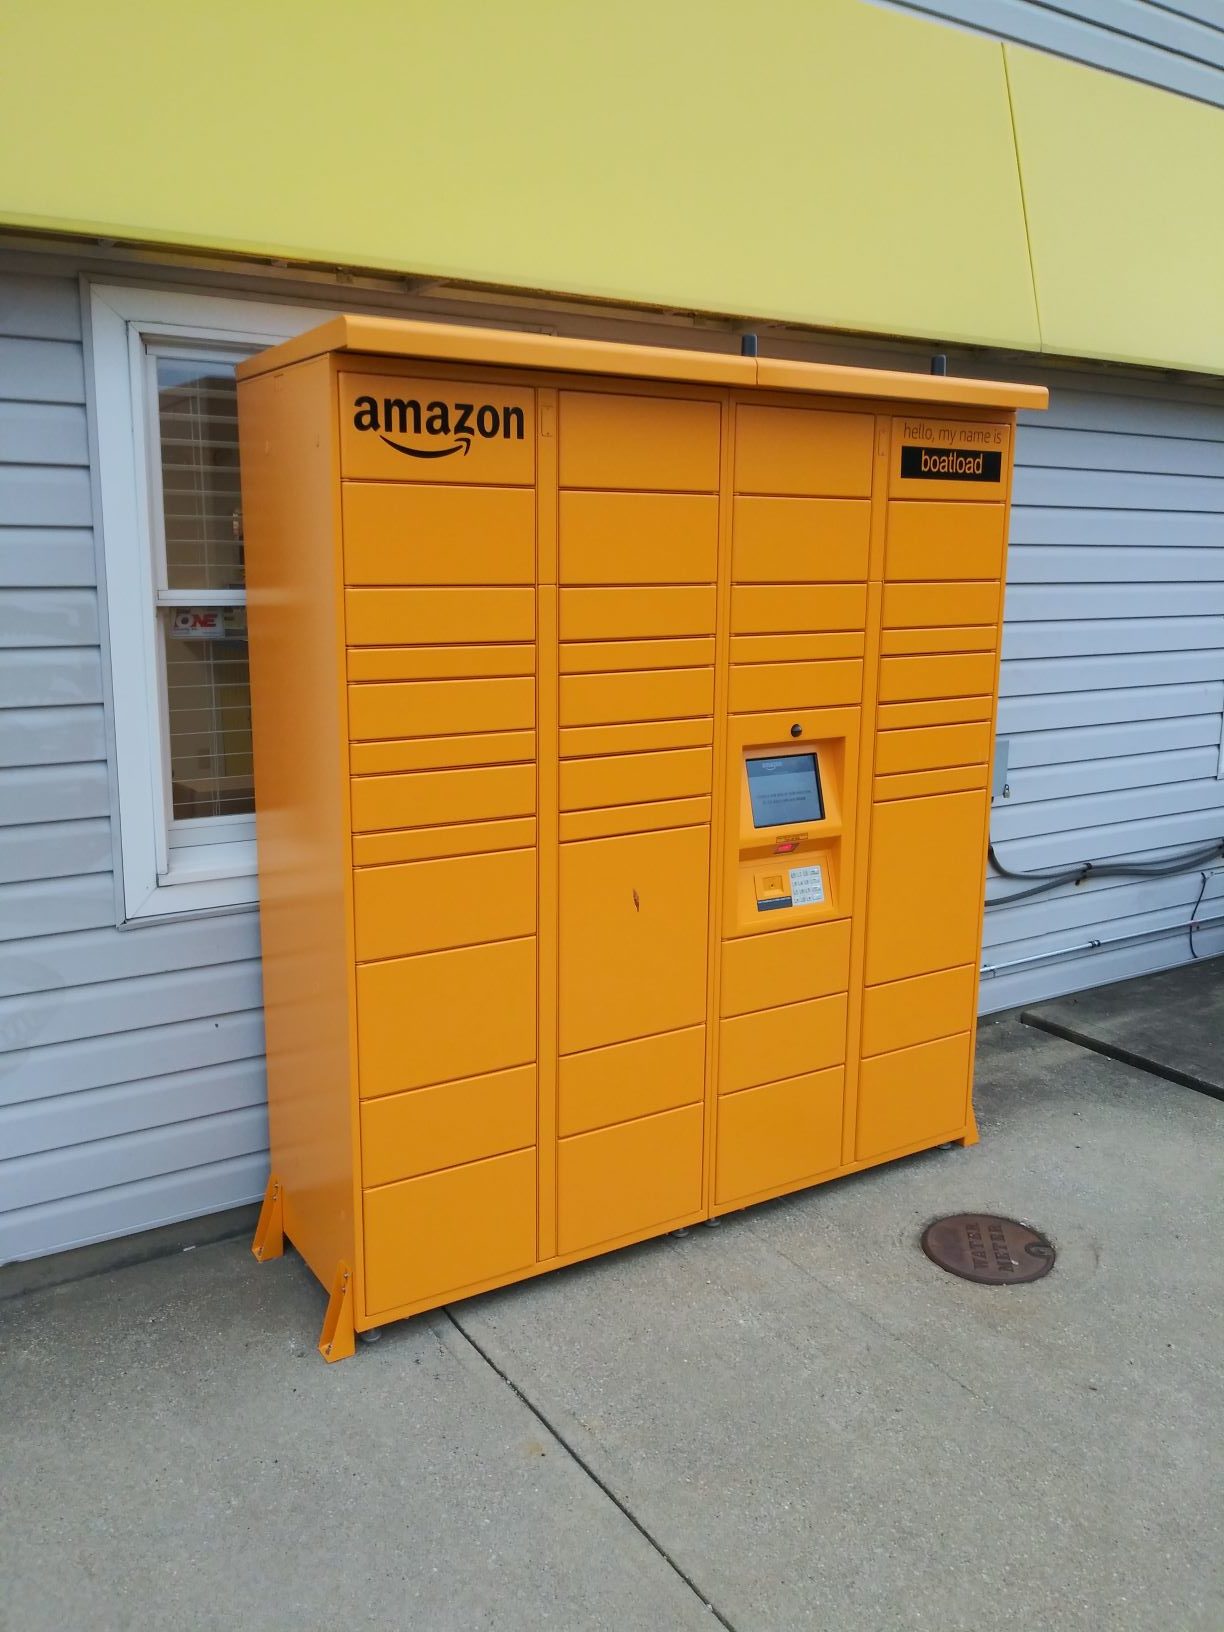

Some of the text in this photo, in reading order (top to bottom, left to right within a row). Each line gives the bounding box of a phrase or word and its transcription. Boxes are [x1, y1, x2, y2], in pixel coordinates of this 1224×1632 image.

[353, 395, 525, 440] amazon
[903, 422, 1002, 445] hello, my name is
[921, 449, 983, 474] boatload
[987, 1224, 1015, 1273] METER
